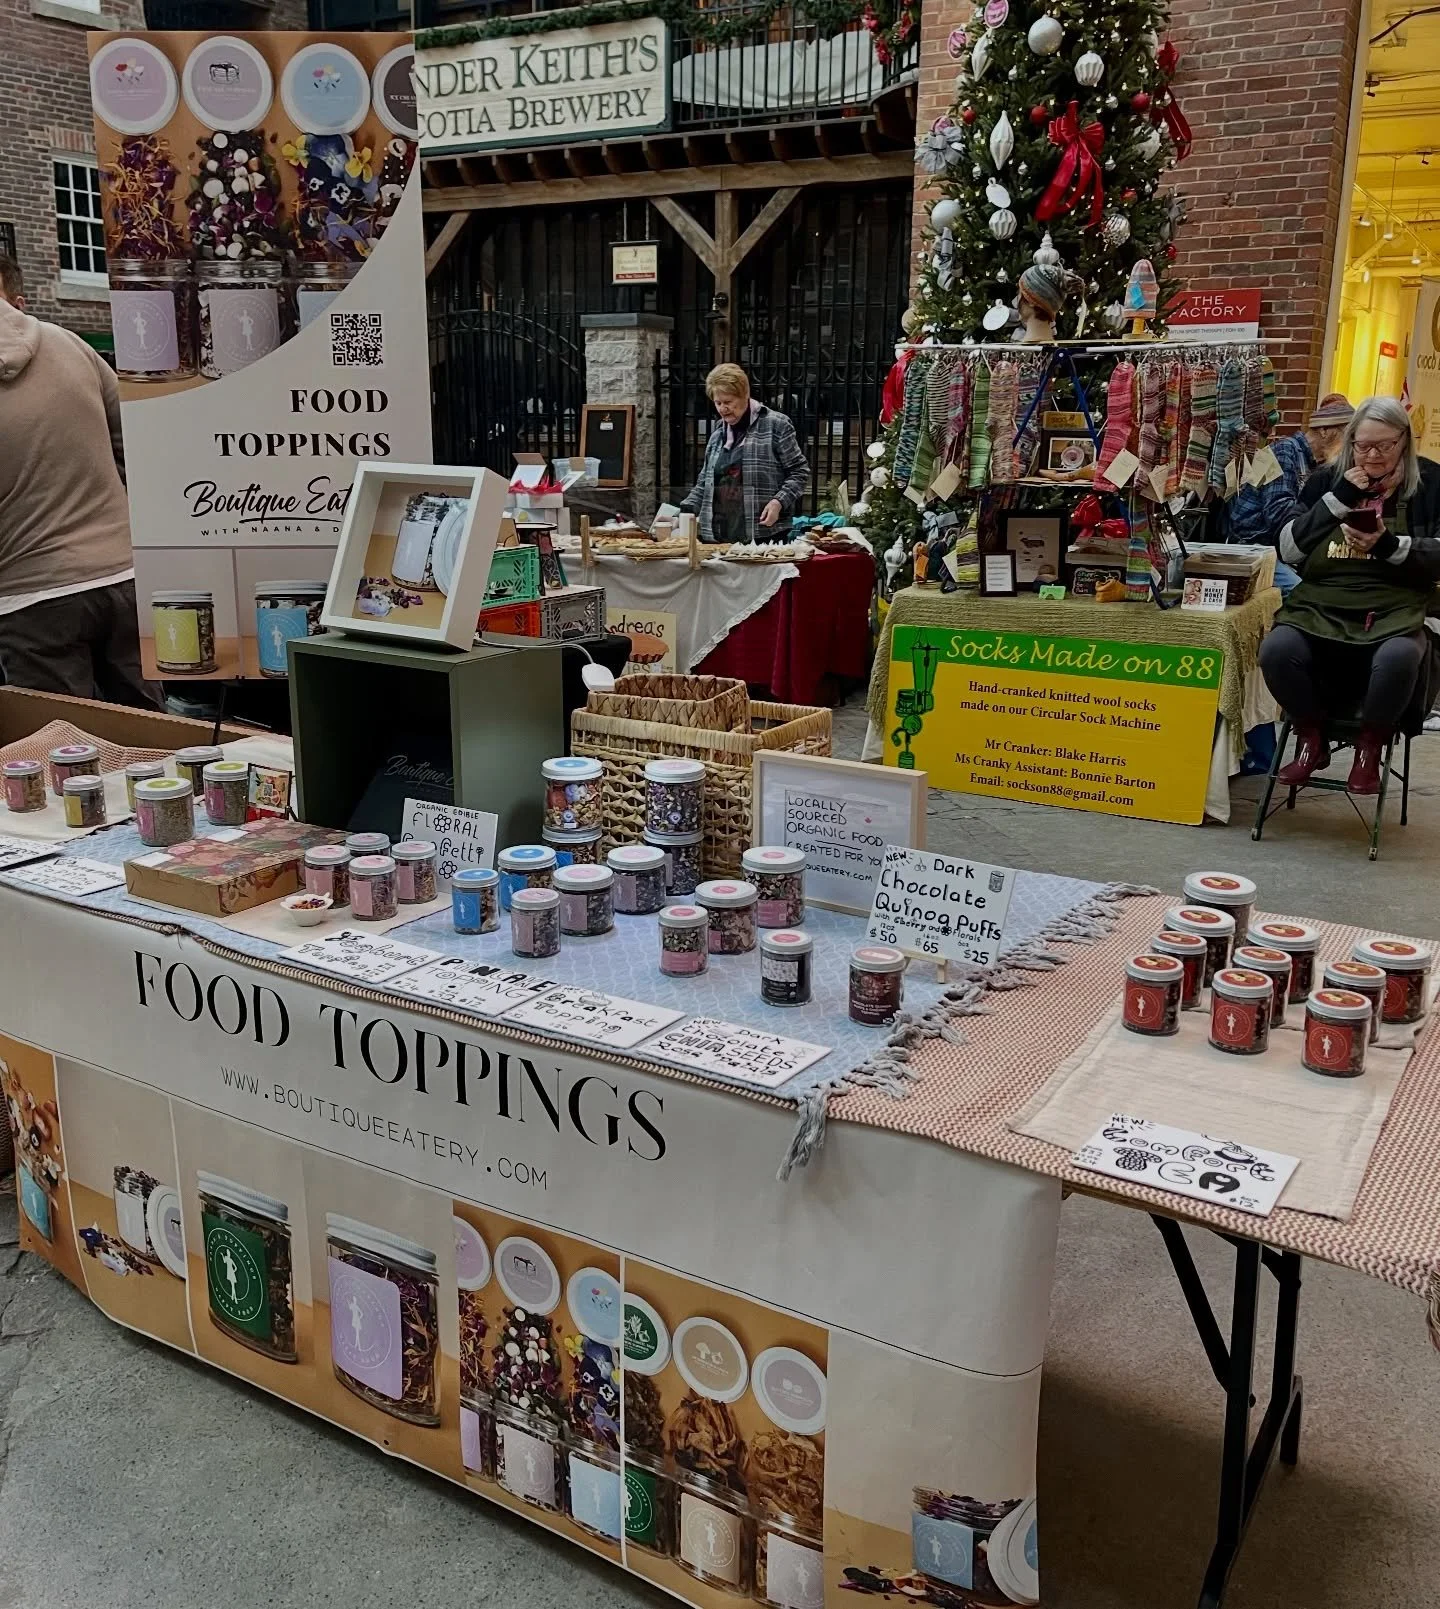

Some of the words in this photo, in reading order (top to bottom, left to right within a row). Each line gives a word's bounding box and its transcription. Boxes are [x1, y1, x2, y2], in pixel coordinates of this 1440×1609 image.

[510, 34, 659, 89] KEITH'S
[507, 88, 651, 130] BREWERY
[1168, 305, 1247, 318] ACTORY
[1191, 295, 1225, 306] THE
[290, 389, 389, 413] FOOD
[214, 432, 391, 457] TOPPINGS
[183, 480, 301, 524] Boutique
[201, 527, 239, 537] WITH
[251, 525, 302, 534] NAANA
[946, 635, 1026, 665] Socks
[1030, 641, 1120, 672] Made
[1123, 654, 1173, 677] on
[1176, 655, 1215, 680] 88
[968, 680, 1047, 700] Hand-cranked
[1049, 687, 1091, 706] knitted
[1093, 692, 1122, 708] wool
[1124, 696, 1157, 712] socks
[960, 699, 990, 713] made
[992, 704, 1006, 714] on
[1008, 706, 1028, 717] our
[1030, 706, 1077, 723] Circular
[1079, 712, 1107, 726] Sock
[1109, 715, 1161, 732] Machine
[984, 738, 1002, 751] Mr
[1003, 741, 1053, 758] Cranker:
[1054, 747, 1087, 762] Blake
[1089, 751, 1127, 768] Harris
[954, 752, 971, 765] Ms
[973, 754, 1012, 773] Cranky
[1014, 761, 1068, 780] Assistant:
[1070, 768, 1112, 785] Bonnie
[1114, 773, 1156, 791] Barton
[788, 795, 847, 813] LOCALLY
[969, 773, 1005, 789] Email:
[1006, 776, 1135, 807] sockson88@gmail.com
[415, 802, 449, 814] ORGANIC
[452, 808, 480, 820] EDIBLE
[788, 808, 847, 825] SOURCED
[786, 821, 846, 840] ORGANIC
[852, 831, 883, 847] FOOD
[844, 851, 864, 862] FOR
[867, 855, 883, 867] YO
[886, 851, 907, 862] NEW
[933, 858, 975, 879] Dark
[881, 868, 986, 909] Chocolate
[874, 912, 890, 921] with
[875, 892, 950, 928] Quinoa
[869, 926, 897, 944] $50
[915, 937, 939, 954] $65
[963, 949, 990, 965] $25
[425, 966, 528, 1000] TOPPING
[533, 1001, 622, 1034] Topping
[544, 992, 660, 1028] Breakfast
[693, 1018, 722, 1026] NEW
[133, 950, 291, 1048] FOOD
[318, 1003, 668, 1161] TOPPINGS
[681, 1025, 785, 1057] Chocolate
[726, 1047, 799, 1070] SEEDS
[220, 1065, 549, 1190] WWW.BOUTIQUEEATERY.COM
[1112, 1116, 1145, 1126] NEW
[1113, 1146, 1241, 1194] TEA
